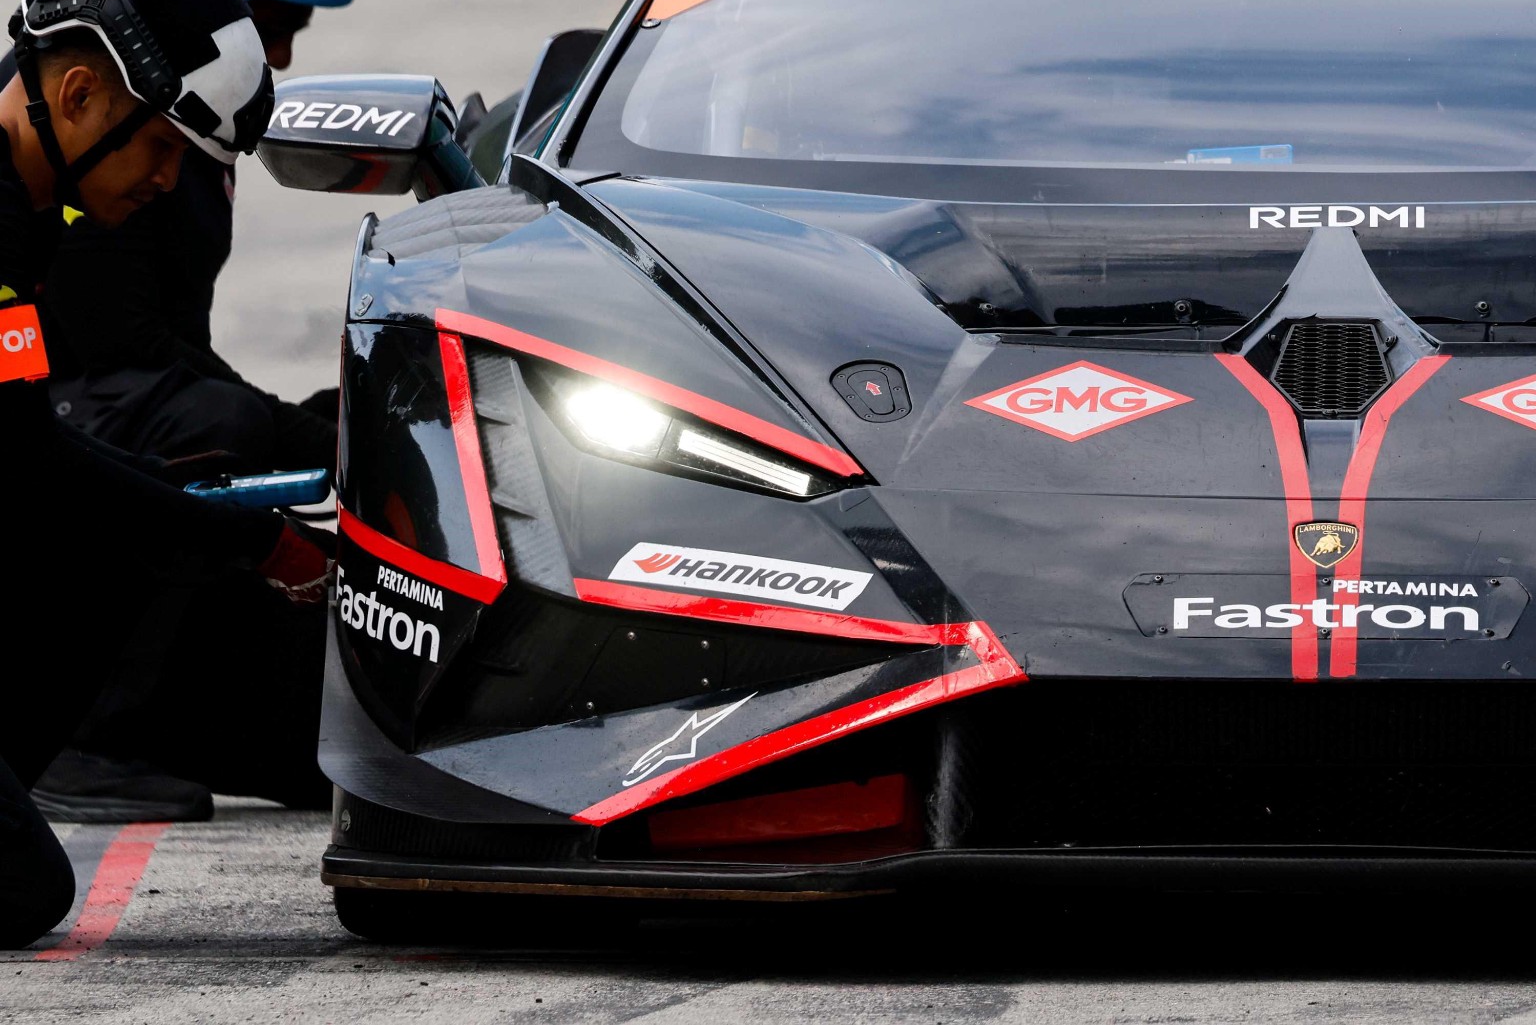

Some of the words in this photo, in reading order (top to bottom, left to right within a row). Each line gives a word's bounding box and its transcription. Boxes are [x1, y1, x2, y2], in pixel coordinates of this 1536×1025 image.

[267, 101, 416, 137] REDMI
[1249, 205, 1426, 229] REDMI
[0, 326, 37, 353] OP
[1006, 386, 1148, 415] GMG
[1299, 524, 1355, 535] LAMBORGHINI
[377, 564, 444, 612] PERTAMINA
[1332, 579, 1479, 597] PERTAMINA
[336, 564, 441, 664] Fastron
[1173, 596, 1479, 632] Fastron
